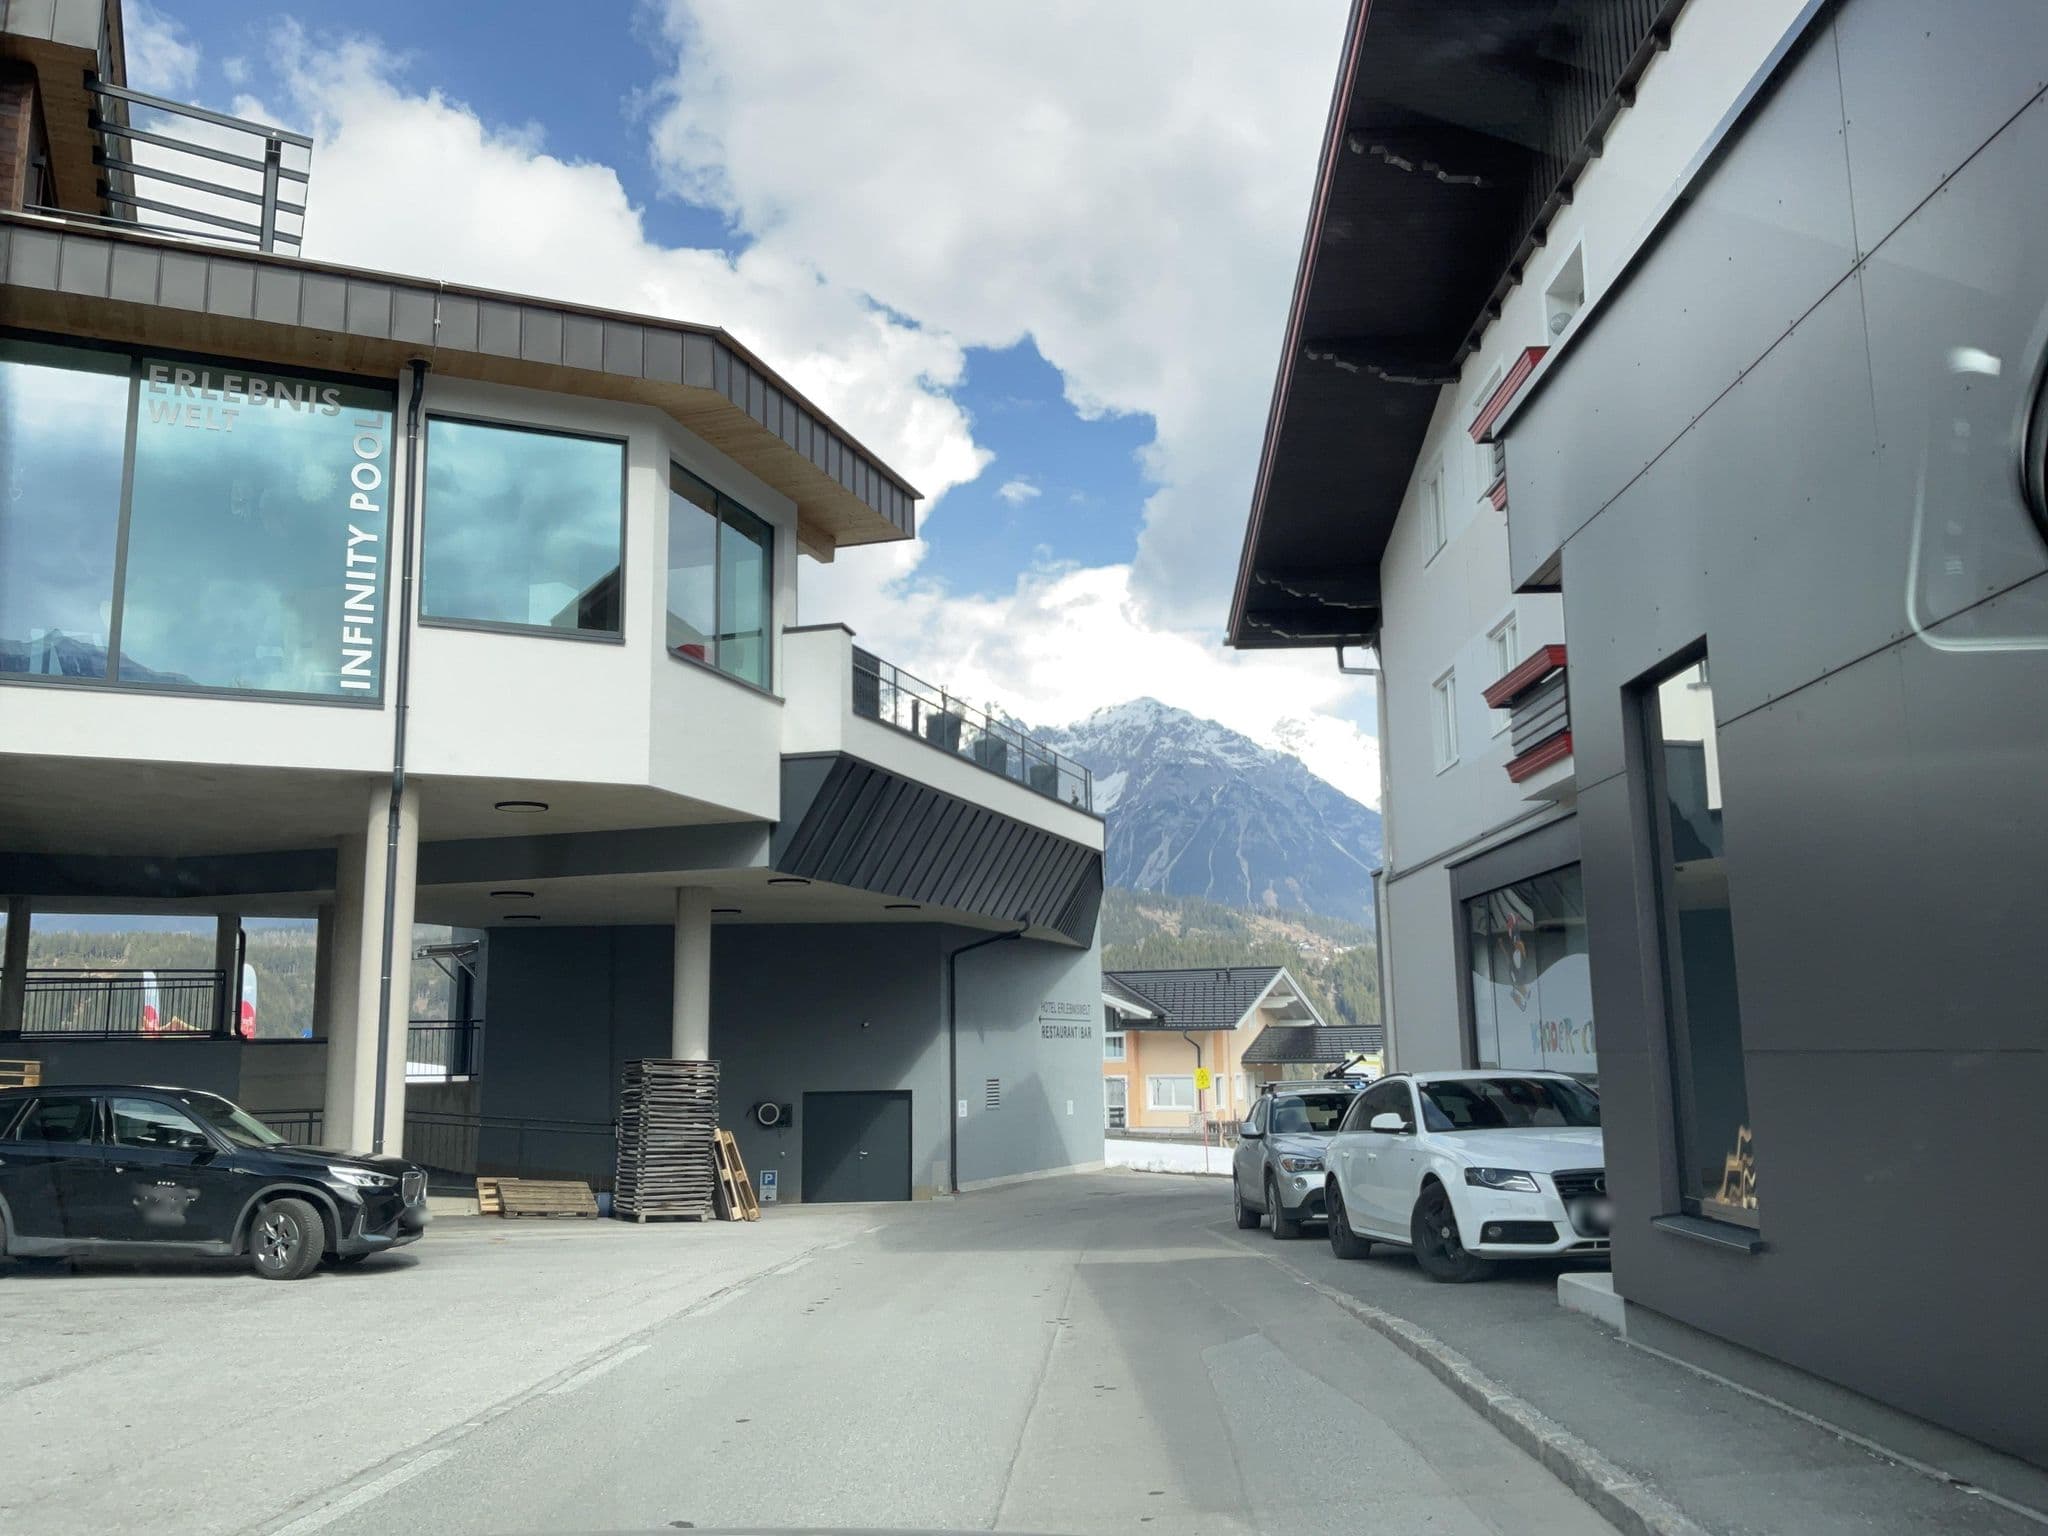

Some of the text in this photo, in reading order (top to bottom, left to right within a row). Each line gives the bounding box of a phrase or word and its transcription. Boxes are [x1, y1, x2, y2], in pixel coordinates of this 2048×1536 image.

[148, 364, 342, 417] ERLEBNIS
[149, 399, 240, 433] WELT
[340, 413, 384, 690] INFINITY POOL
[1057, 1002, 1091, 1015] ERLEBWELT
[1041, 1025, 1092, 1039] RESTAURANT BAR
[764, 1173, 773, 1185] P
